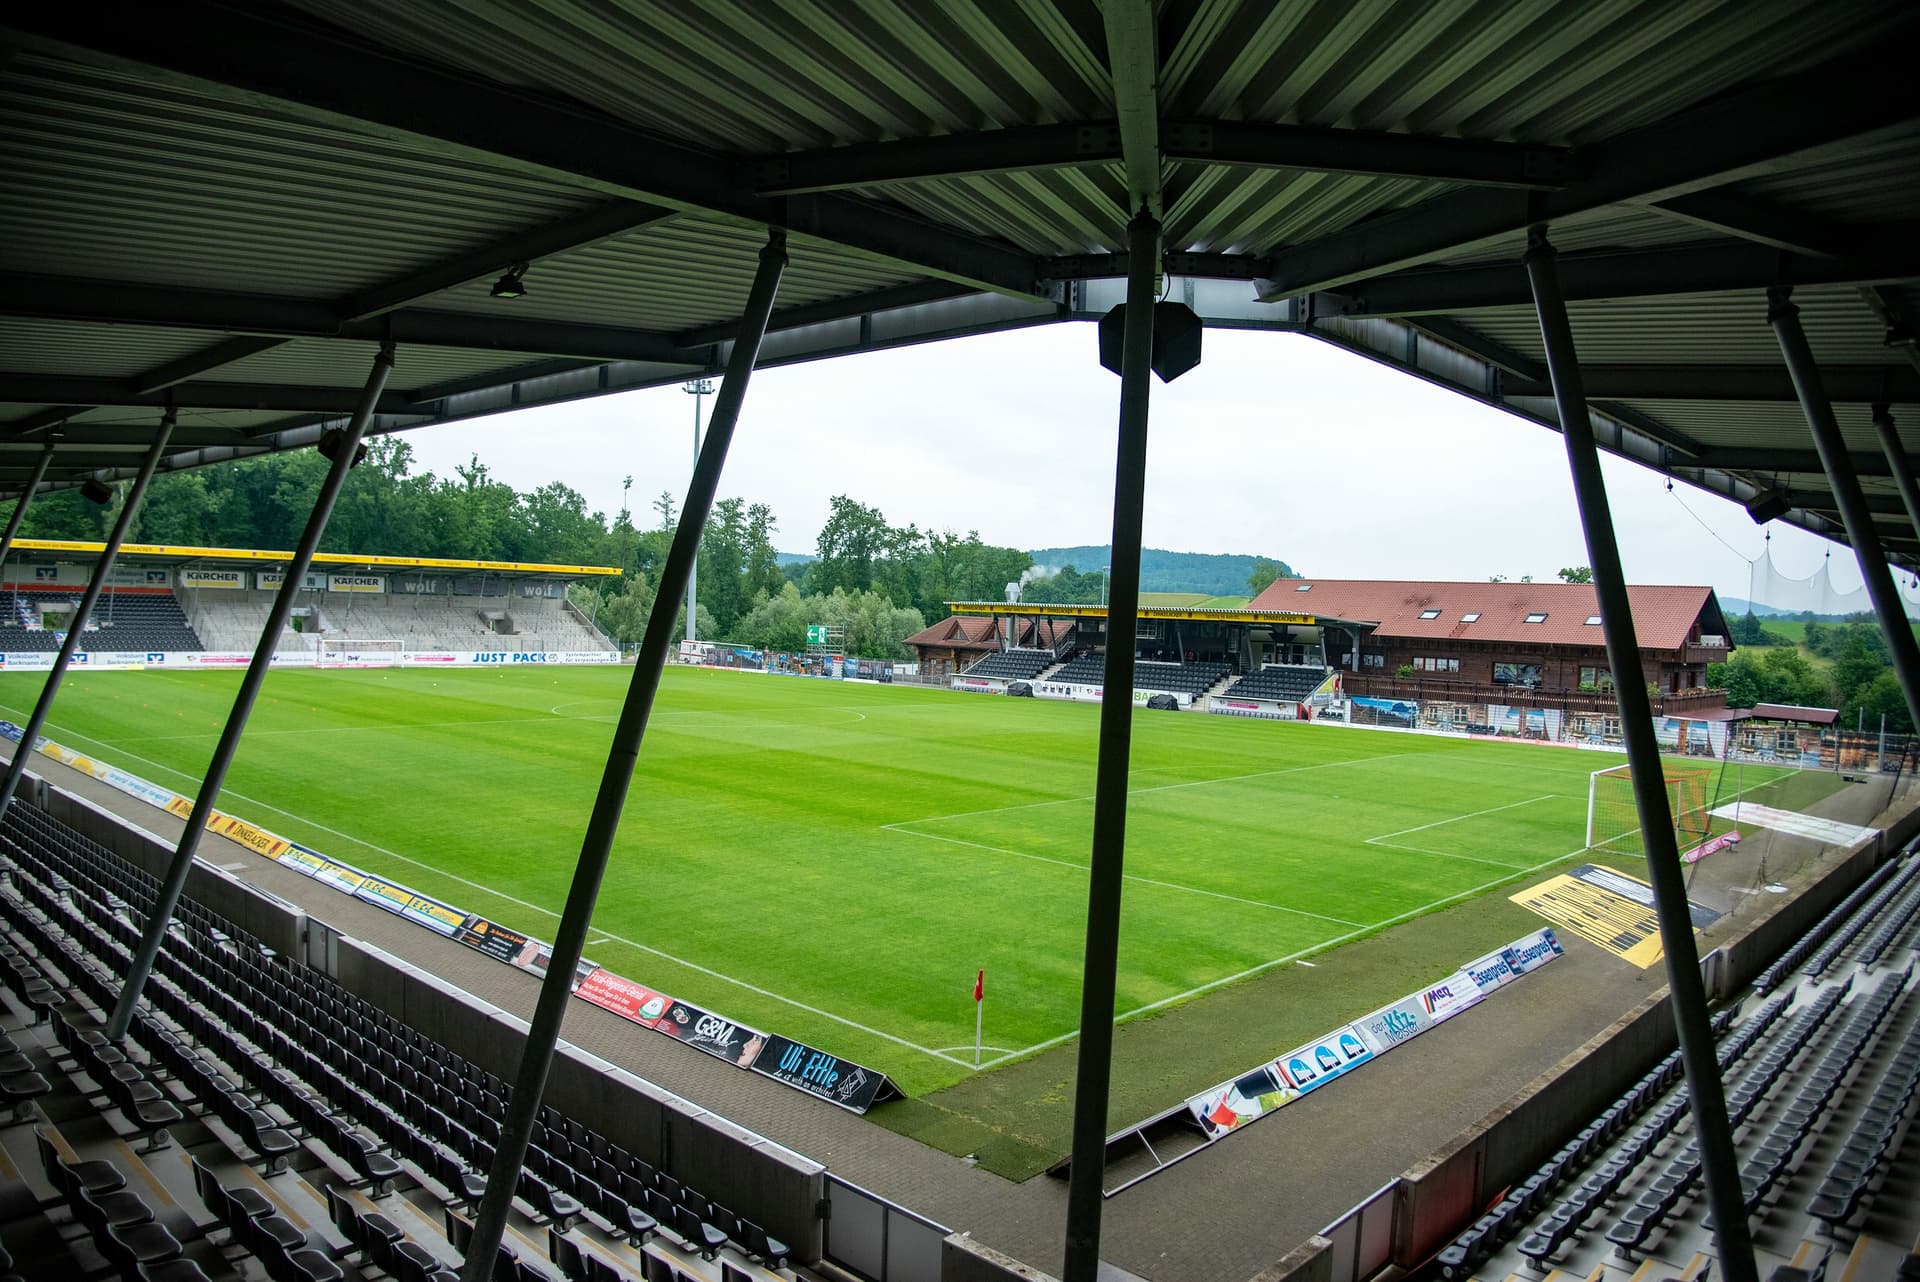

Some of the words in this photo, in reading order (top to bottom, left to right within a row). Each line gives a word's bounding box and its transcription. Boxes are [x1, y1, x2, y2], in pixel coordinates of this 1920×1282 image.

[404, 580, 437, 593] wolf
[524, 584, 553, 597] wolf
[473, 653, 508, 663] JUST
[513, 653, 547, 663] PACK
[694, 1014, 736, 1043] G&M
[1385, 1021, 1419, 1044] Meister
[779, 1043, 806, 1073] Uli
